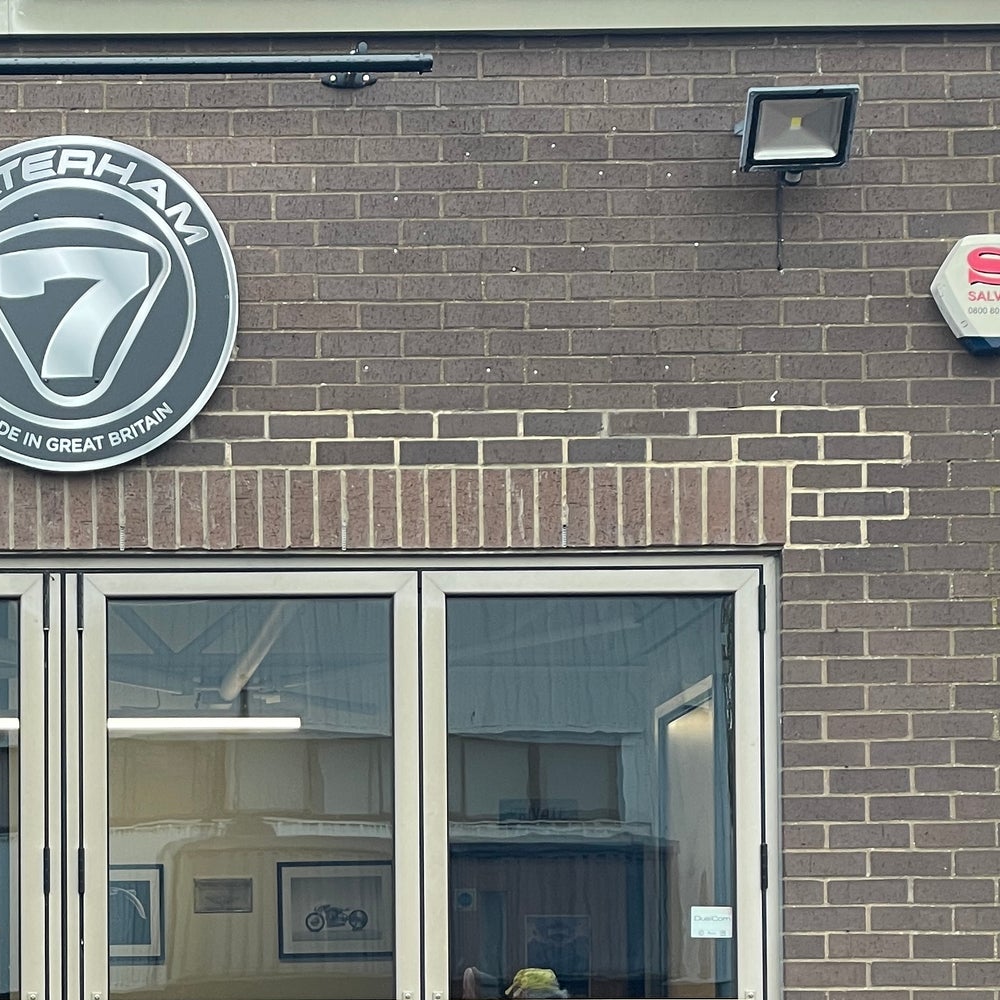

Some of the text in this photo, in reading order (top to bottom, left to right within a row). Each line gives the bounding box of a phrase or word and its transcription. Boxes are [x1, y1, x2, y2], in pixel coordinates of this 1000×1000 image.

[968, 306, 988, 315] 0800
[22, 431, 43, 450] IN
[46, 435, 105, 453] GREAT
[108, 401, 174, 447] BRITAIN
